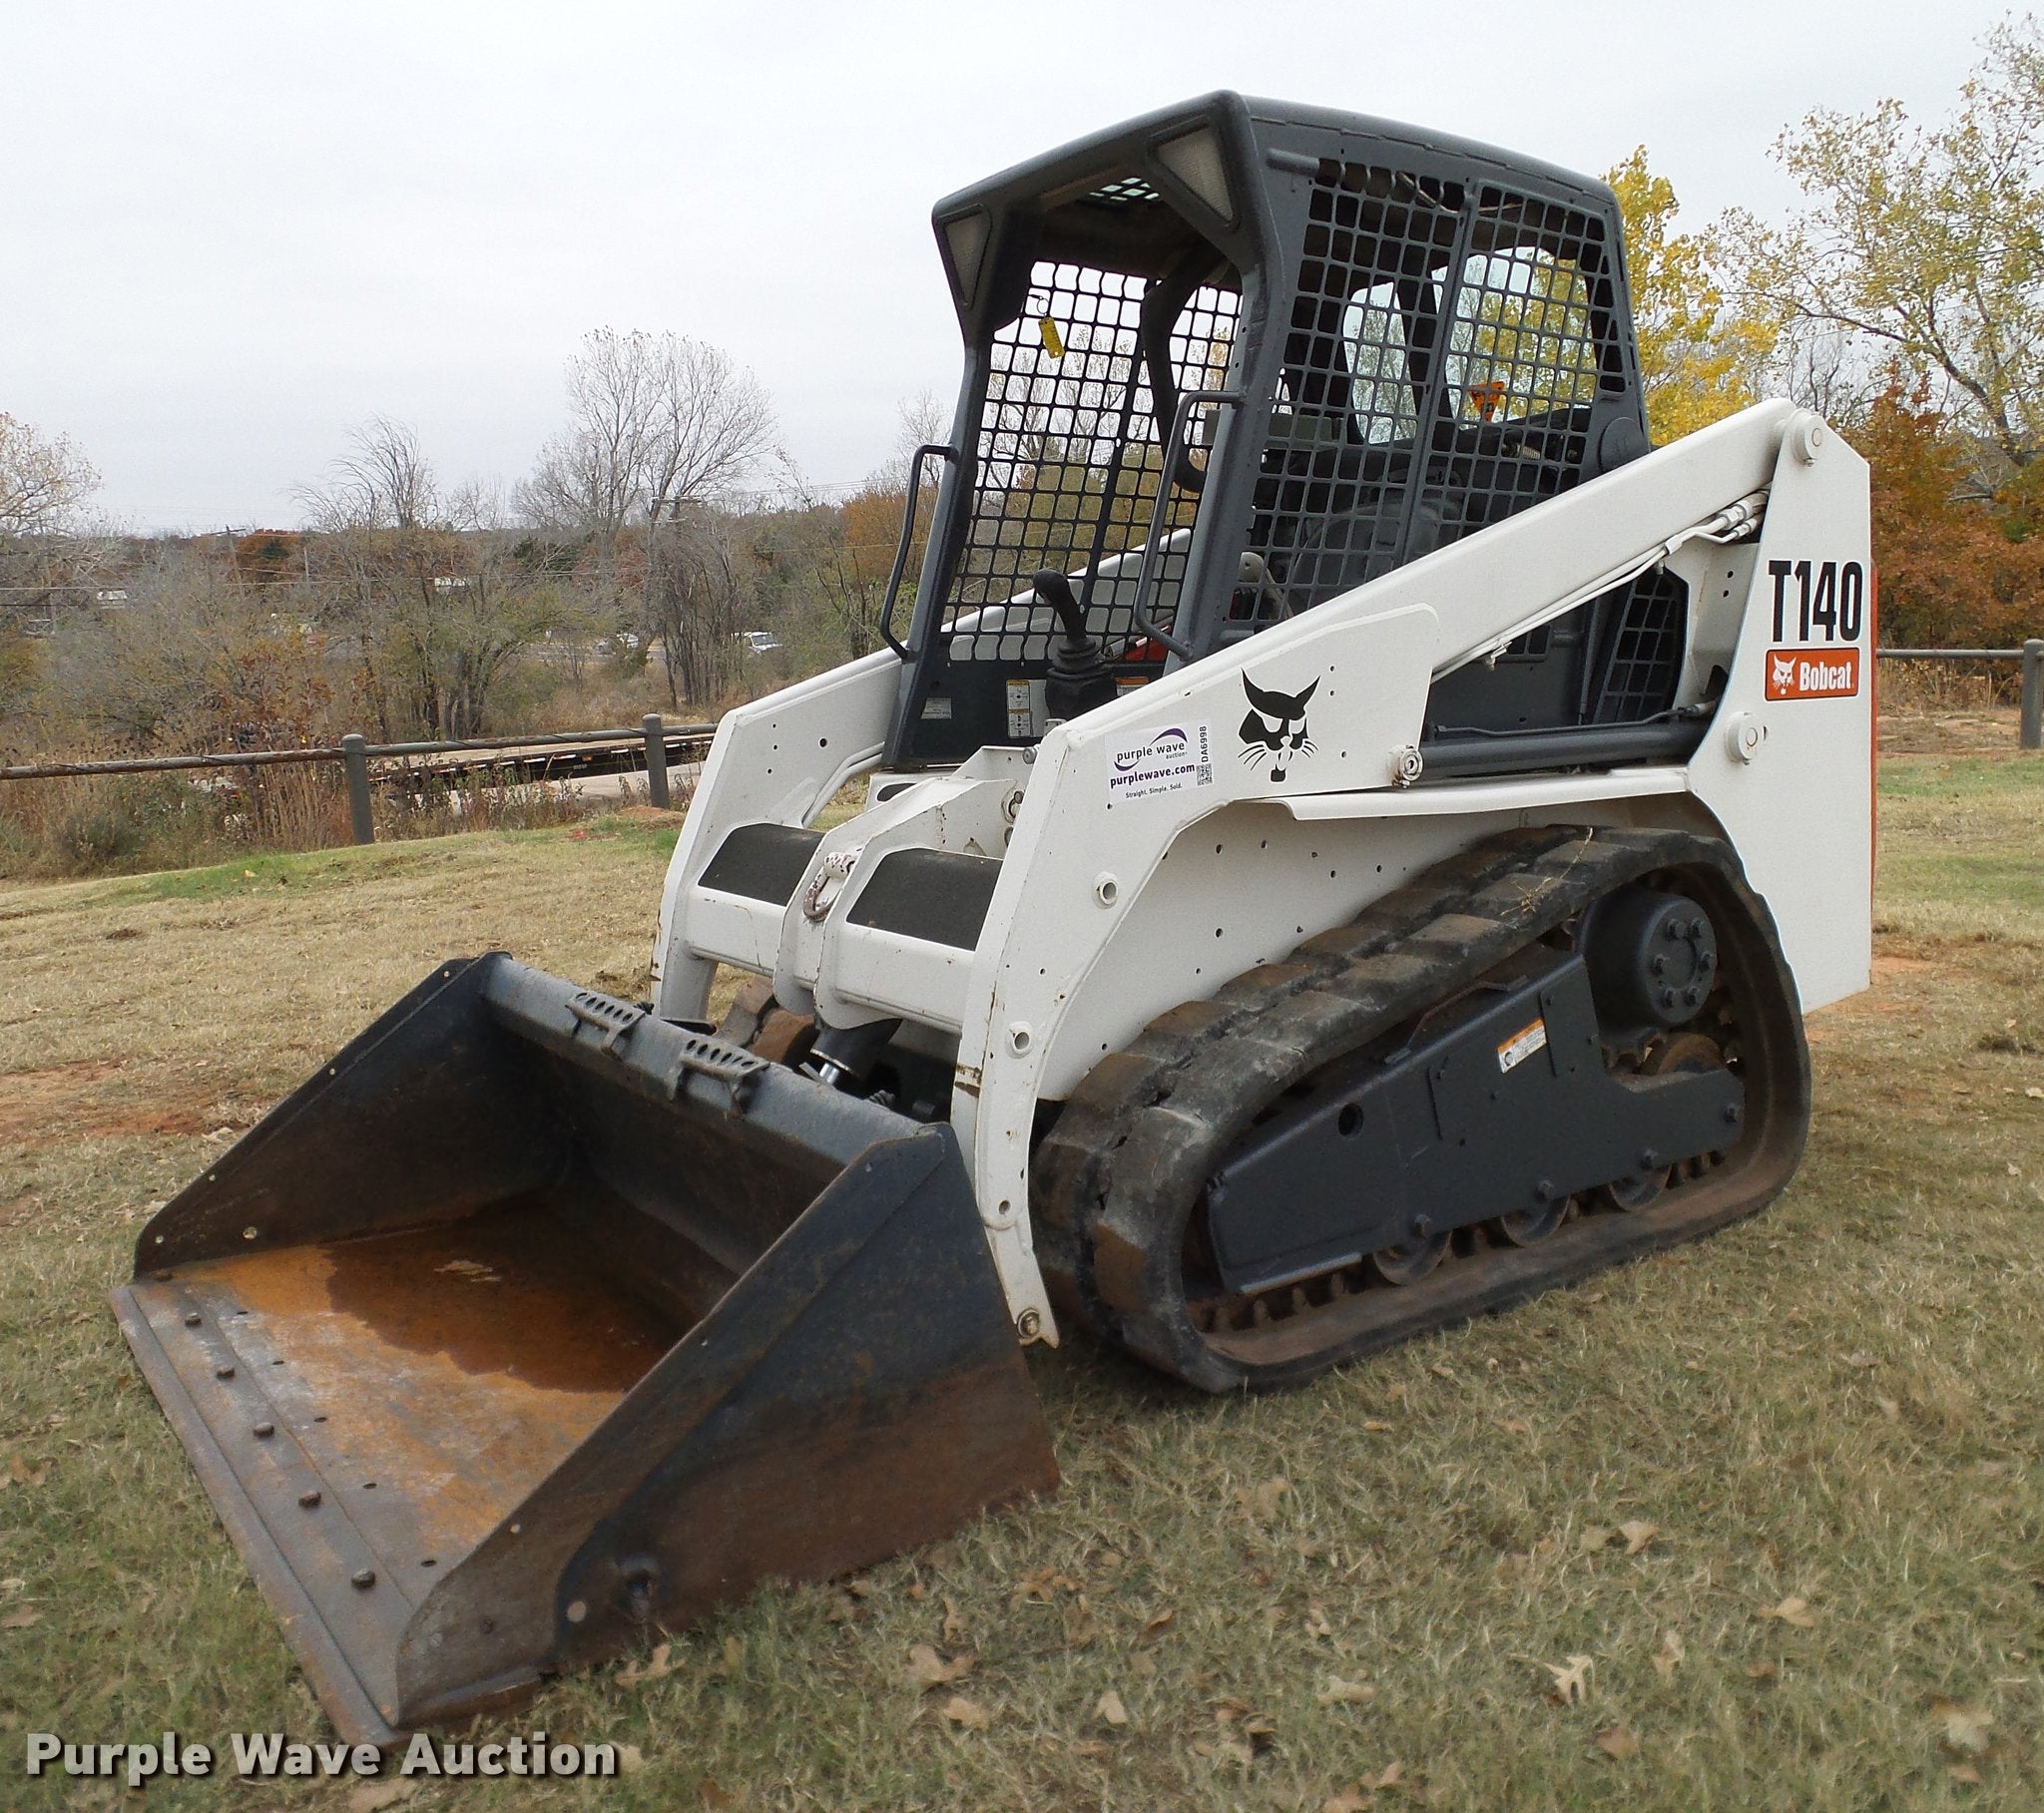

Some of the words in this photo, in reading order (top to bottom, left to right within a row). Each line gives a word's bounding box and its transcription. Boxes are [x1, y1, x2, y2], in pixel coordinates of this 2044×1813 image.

[1769, 560, 1863, 643] T140
[1798, 661, 1852, 691] Bobcat
[1117, 746, 1153, 762] purple
[1156, 742, 1185, 754] wave
[1199, 725, 1209, 763] DA6998
[1110, 764, 1196, 789] purplewave.com
[1125, 788, 1148, 798] Straight.
